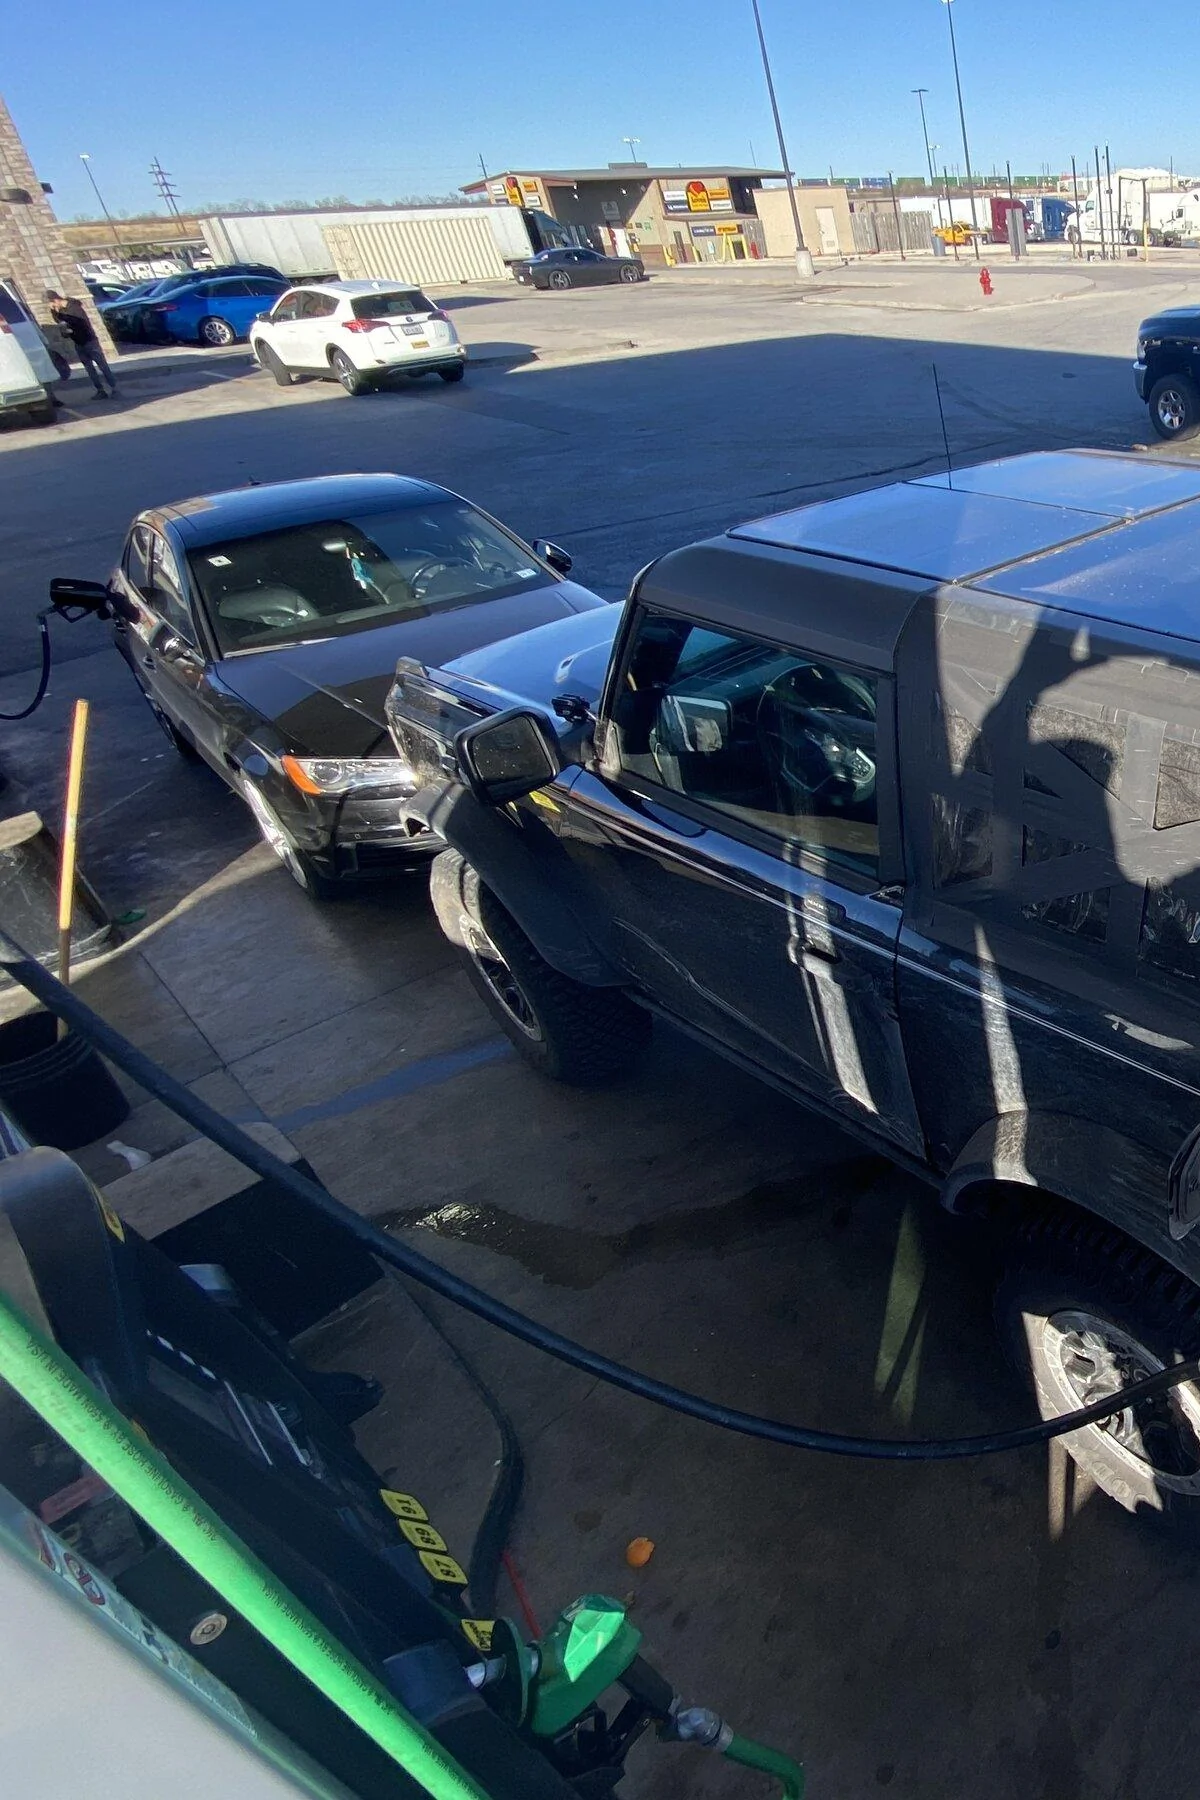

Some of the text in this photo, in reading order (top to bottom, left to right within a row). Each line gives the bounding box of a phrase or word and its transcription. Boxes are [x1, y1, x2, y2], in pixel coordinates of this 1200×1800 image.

[25, 1336, 49, 1362] USA
[396, 1498, 417, 1516] 91
[415, 1527, 436, 1547] 89
[434, 1559, 456, 1579] 87
